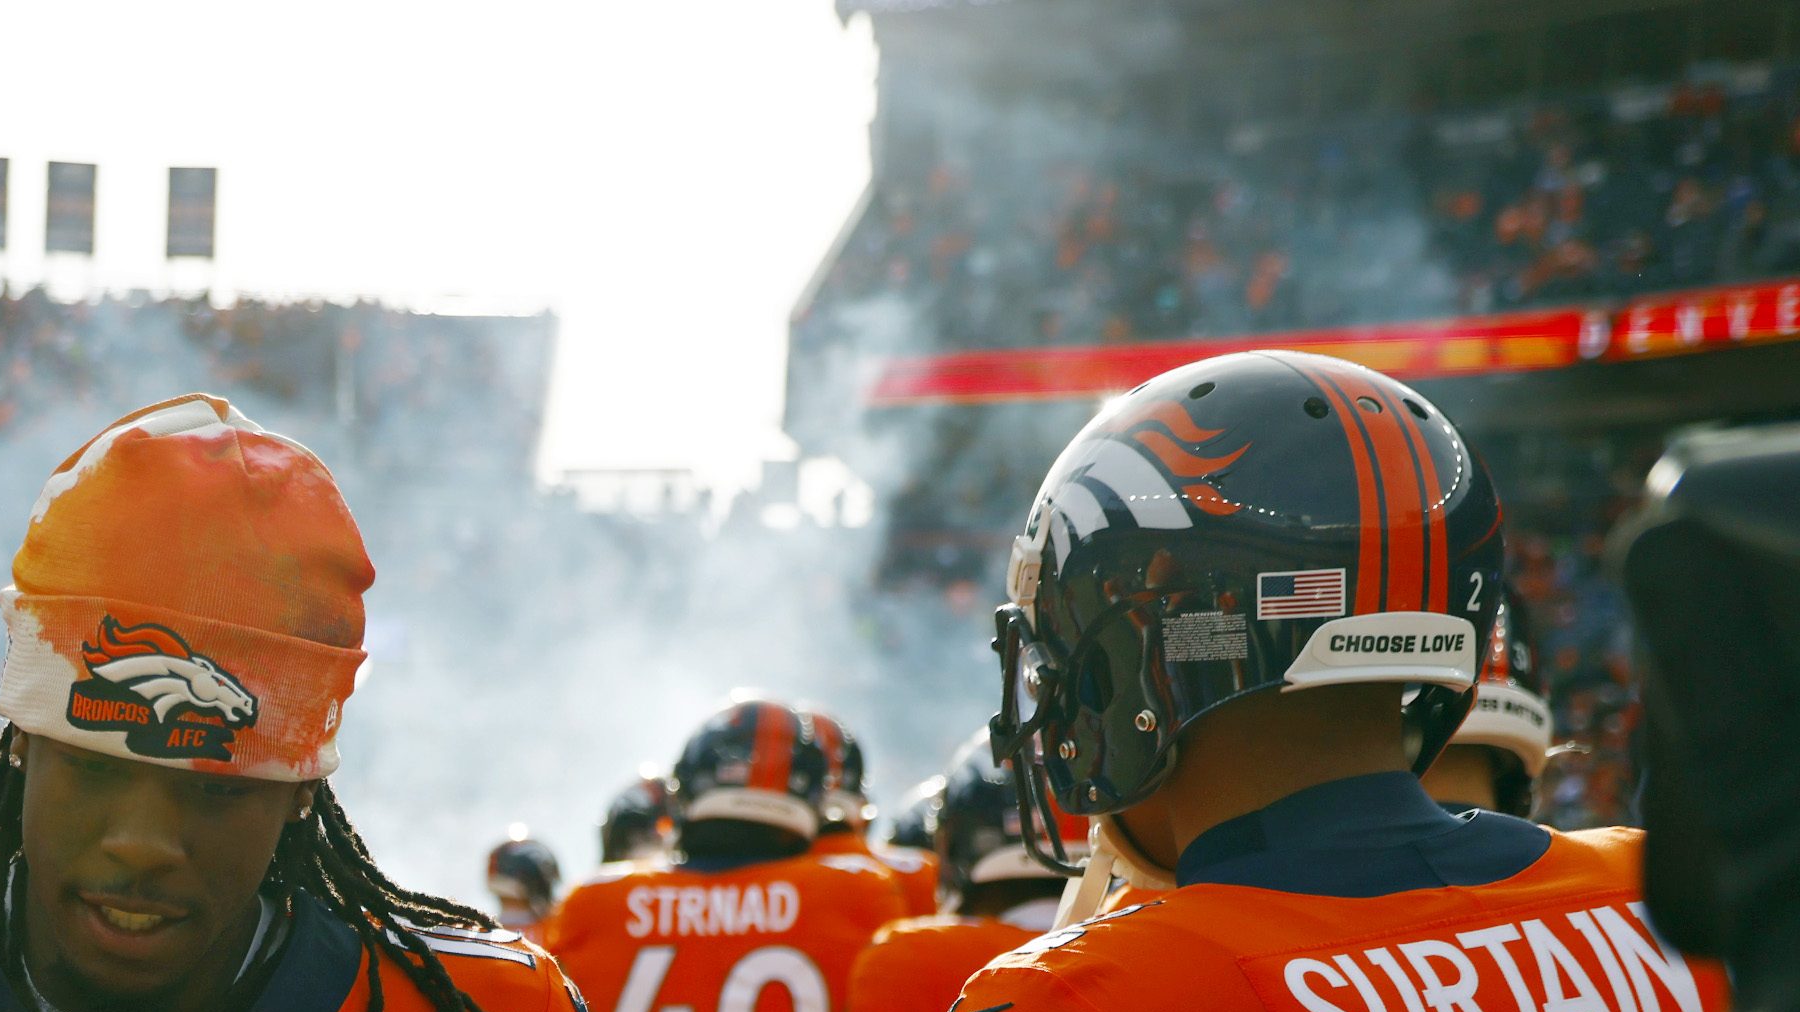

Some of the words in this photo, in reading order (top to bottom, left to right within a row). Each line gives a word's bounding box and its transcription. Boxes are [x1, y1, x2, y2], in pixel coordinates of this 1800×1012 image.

[1466, 571, 1484, 612] 2
[1330, 635, 1417, 653] CHOOSE
[1421, 633, 1465, 652] LOVE
[71, 691, 151, 725] BRONCOS
[166, 728, 208, 748] AFC
[625, 880, 800, 938] STRNAD
